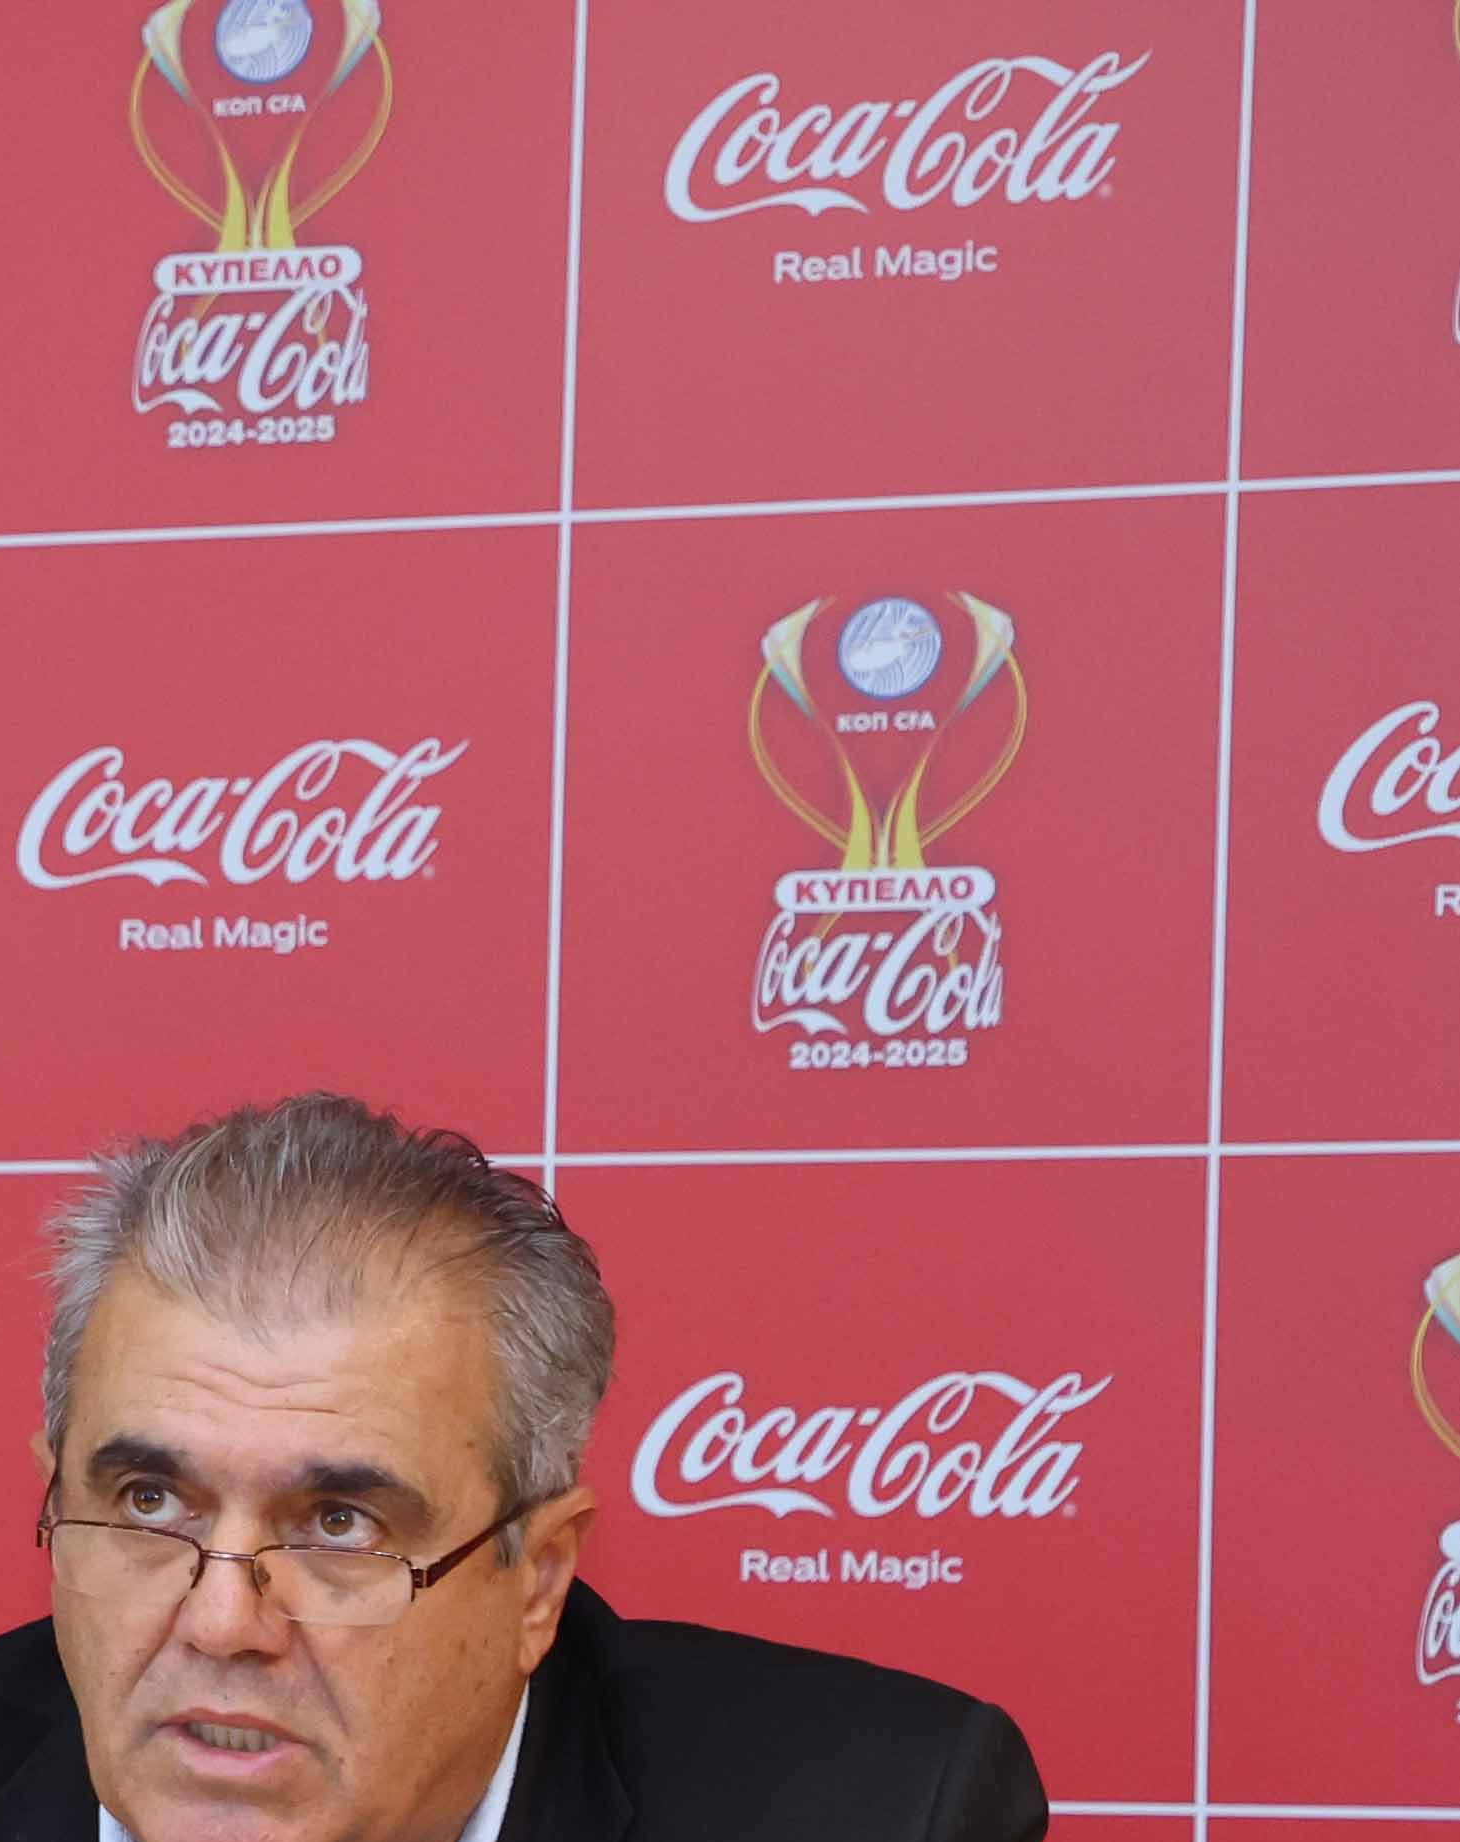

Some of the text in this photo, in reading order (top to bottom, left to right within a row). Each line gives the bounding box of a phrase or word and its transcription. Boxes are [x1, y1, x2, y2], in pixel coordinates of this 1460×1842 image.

[665, 52, 1150, 222] Coca-Cola
[172, 254, 344, 284] ΚΥΠΕΛΛΟ
[774, 240, 997, 283] Real Magic
[168, 415, 334, 448] 2024-2025
[838, 711, 935, 732] ΚΟΠ CFA
[17, 738, 468, 889] Coca-Cola
[794, 875, 977, 904] ΚΥΠΕΛΛΟ
[120, 914, 328, 954] Real Magic
[790, 1039, 967, 1068] 2024-2025
[631, 1372, 1112, 1518] Coca-Cola
[741, 1549, 963, 1589] Real Magic
